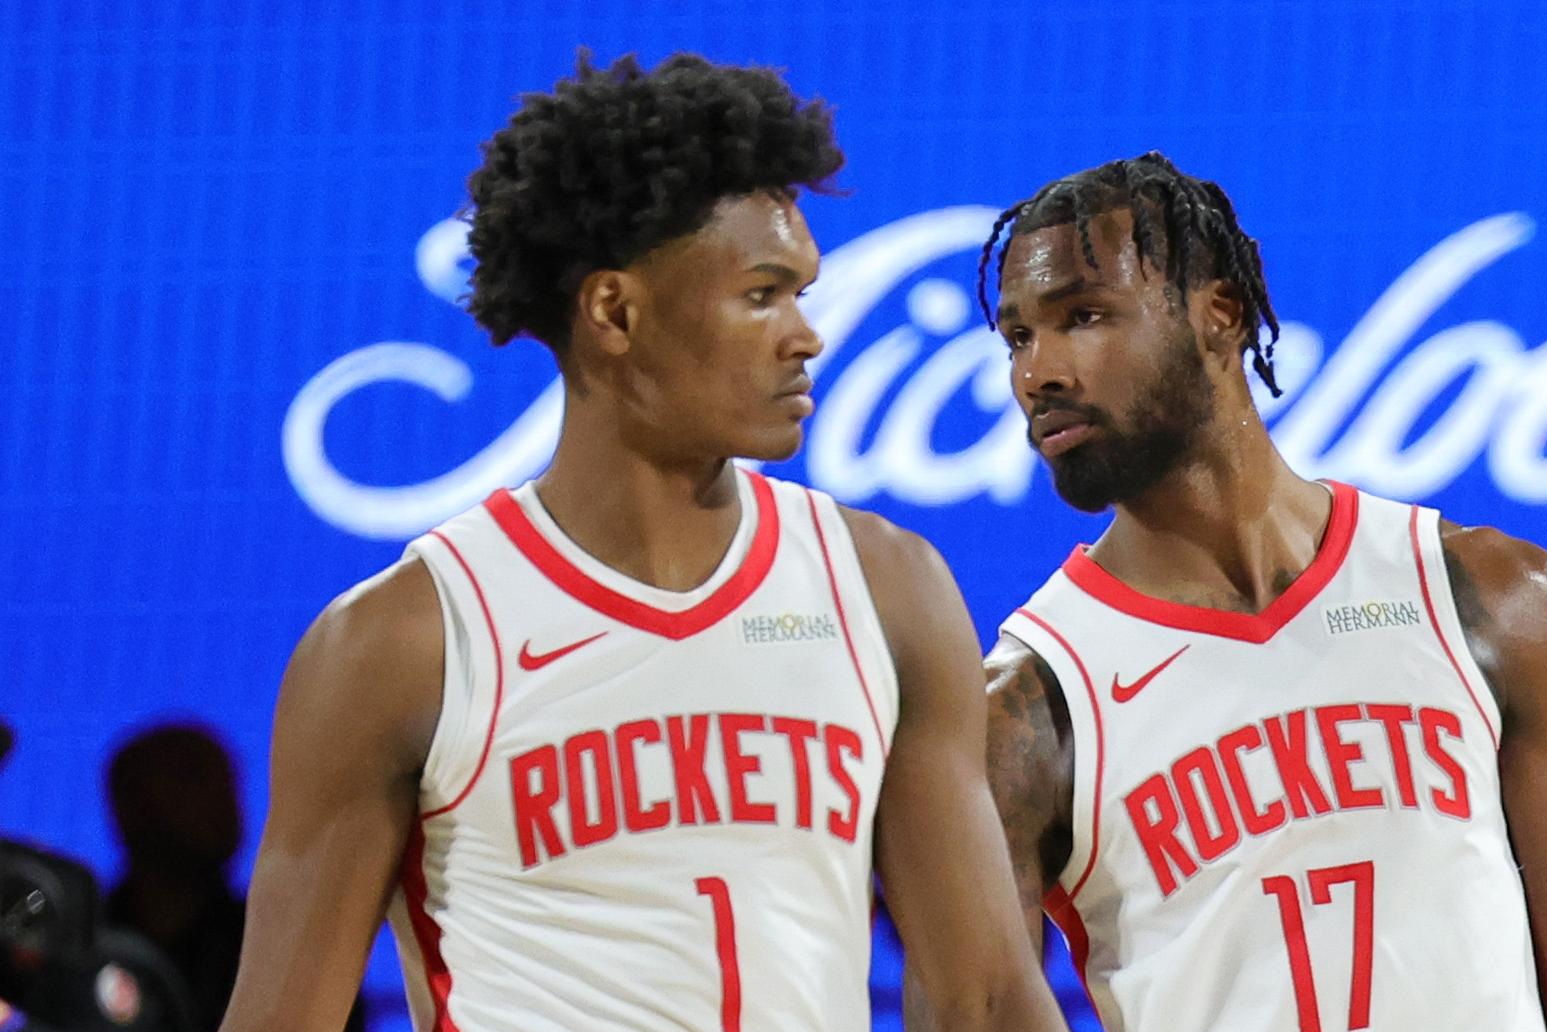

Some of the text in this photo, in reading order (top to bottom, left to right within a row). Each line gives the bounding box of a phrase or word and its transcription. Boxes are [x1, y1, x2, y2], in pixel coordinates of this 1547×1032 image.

[1326, 601, 1419, 621] MEMORIAL
[1328, 609, 1420, 634] HERMANN
[508, 712, 863, 870] ROCKETS
[1122, 702, 1473, 899] ROCKETS
